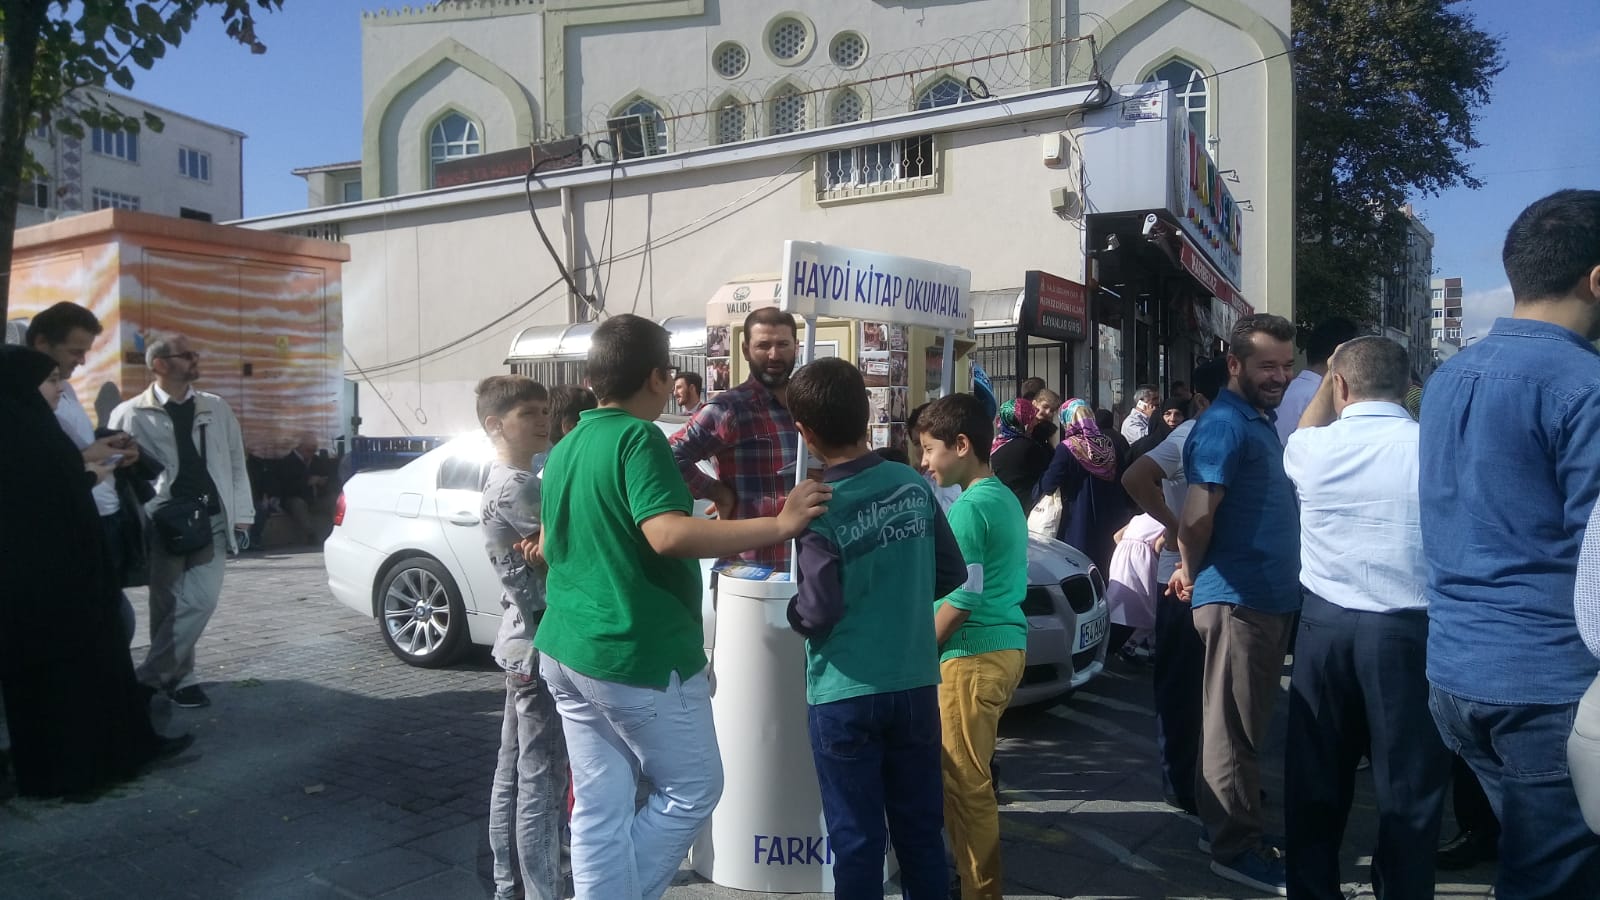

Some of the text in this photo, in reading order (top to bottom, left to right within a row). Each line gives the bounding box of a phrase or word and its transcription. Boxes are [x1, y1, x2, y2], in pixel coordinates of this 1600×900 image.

[793, 260, 967, 319] HAYDİ KİTAP OKUMAYA...
[1042, 314, 1067, 330] BAYANLAR
[835, 484, 928, 548] California
[878, 511, 927, 548] Party
